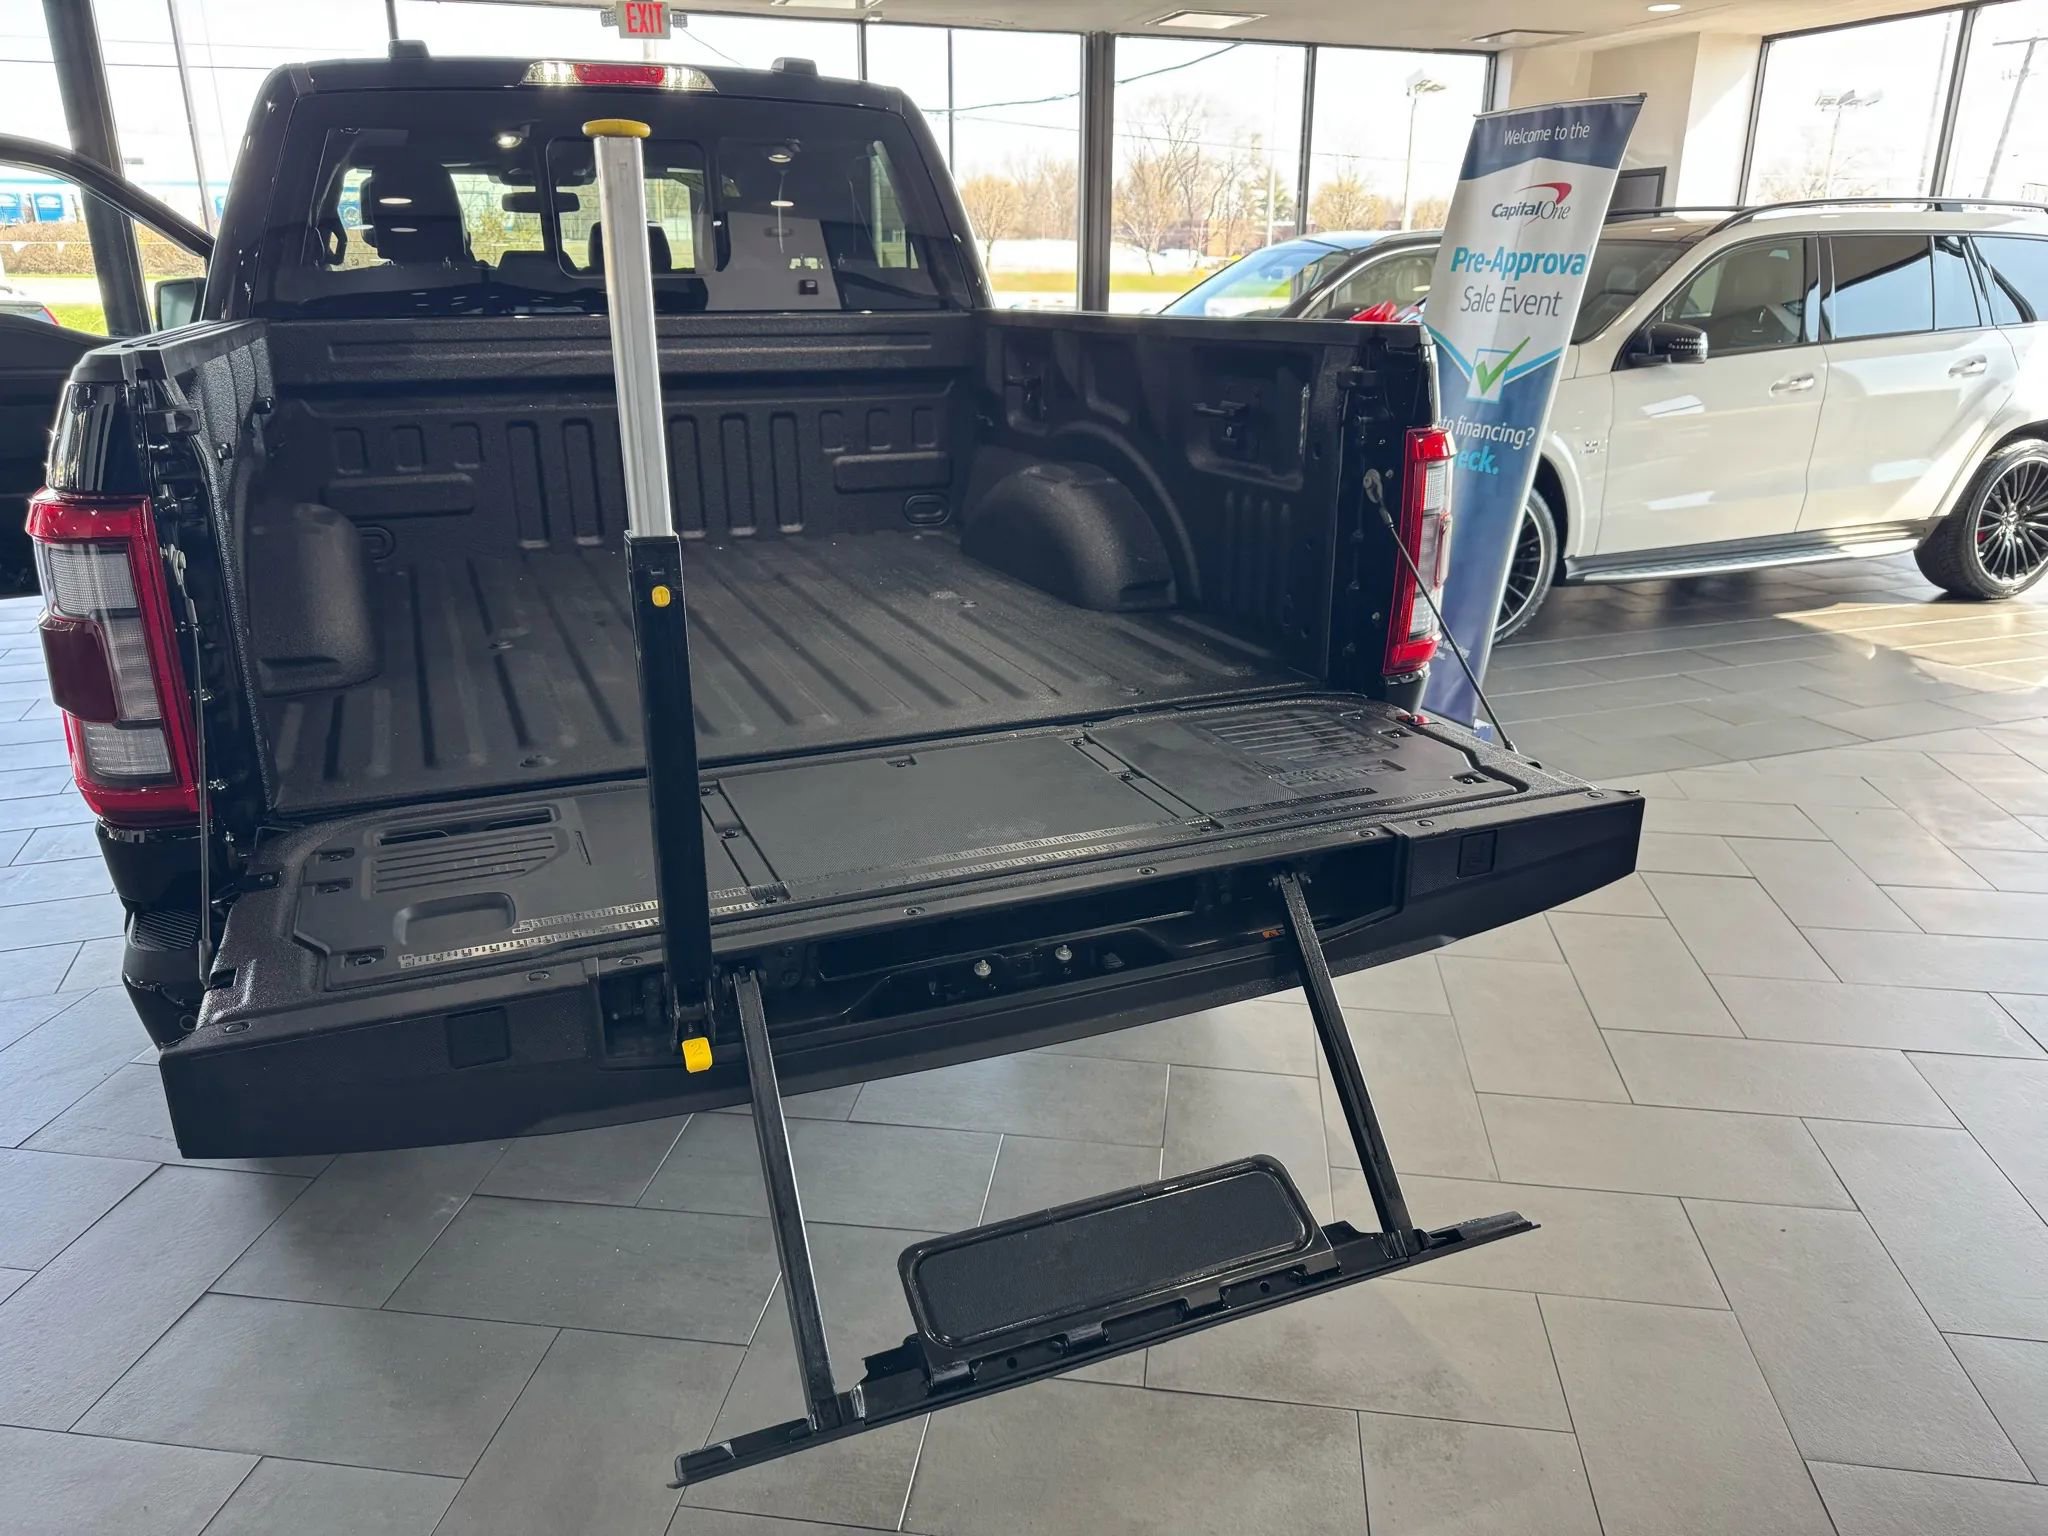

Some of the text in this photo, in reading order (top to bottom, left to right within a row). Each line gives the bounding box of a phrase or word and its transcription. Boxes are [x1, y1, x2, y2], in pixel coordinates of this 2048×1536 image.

[625, 2, 663, 33] EXIT
[1504, 121, 1590, 146] Welcome to the
[1460, 284, 1563, 317] Sale Event
[1455, 415, 1536, 450] financing?
[1456, 444, 1499, 475] eck.
